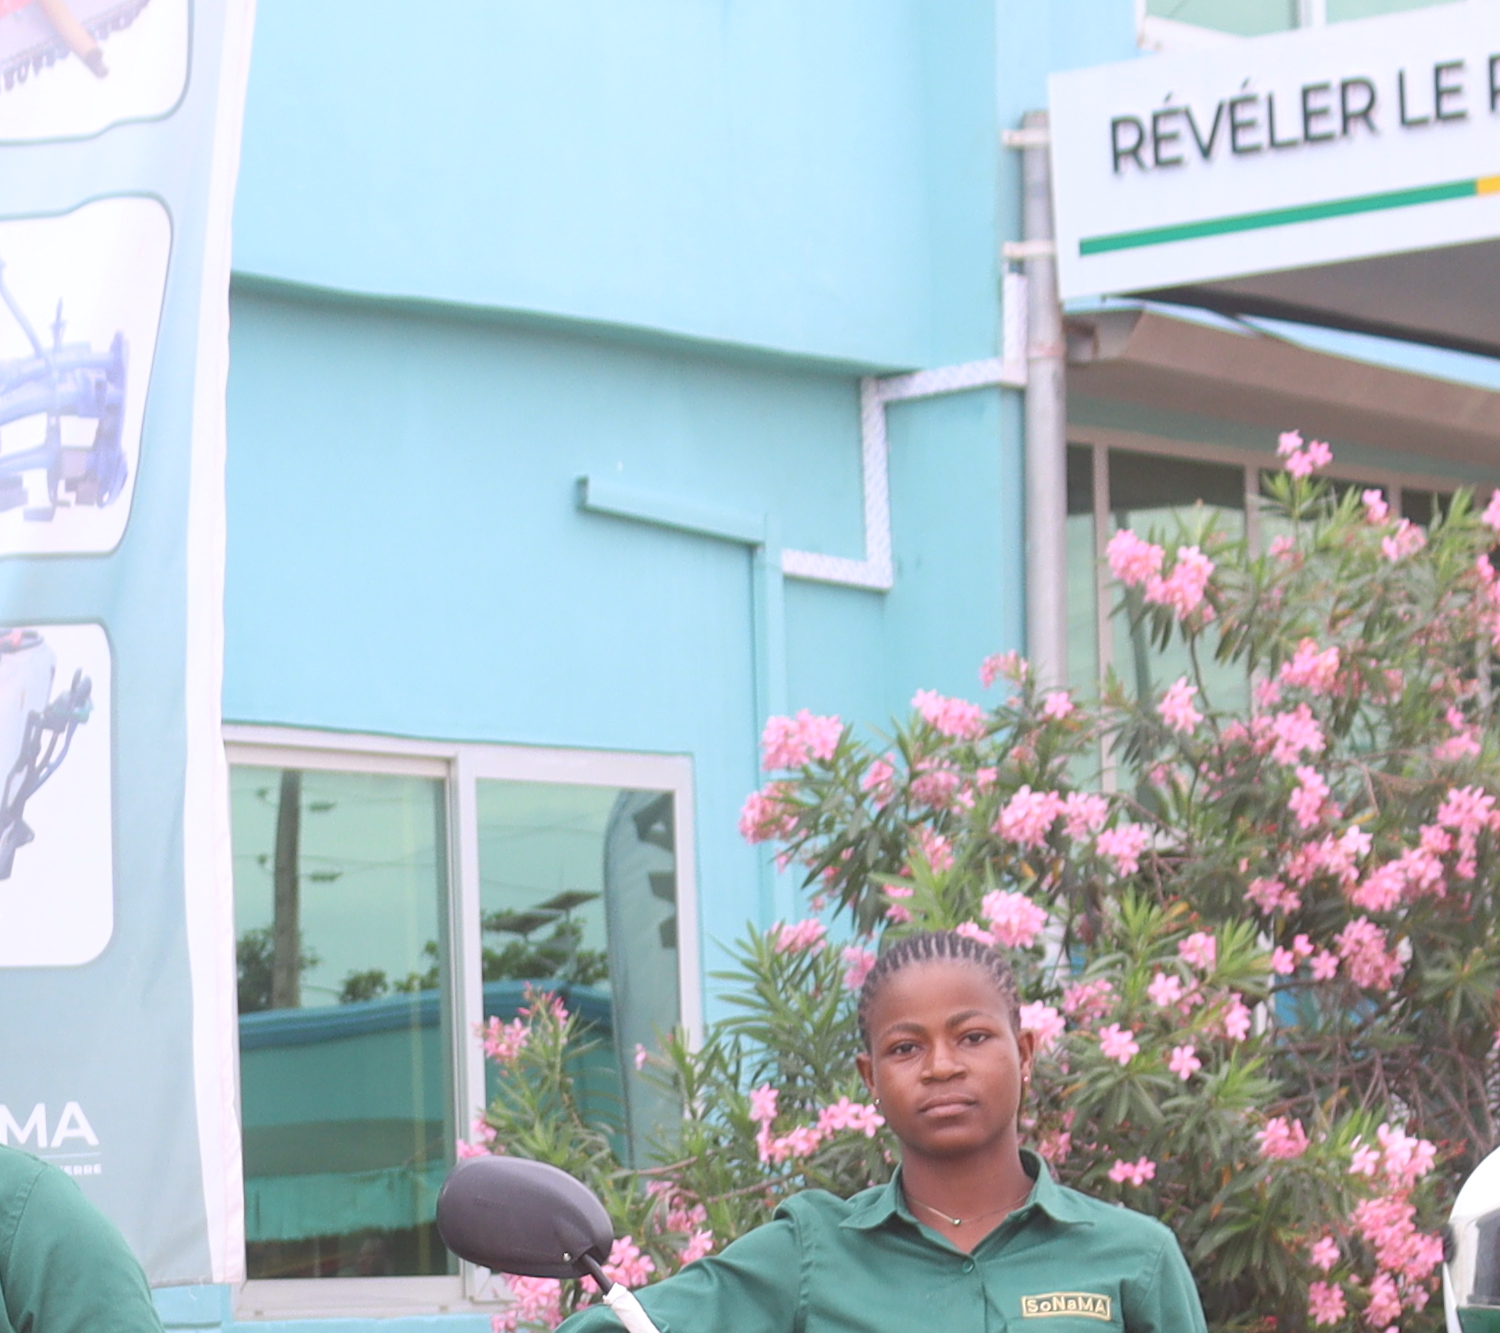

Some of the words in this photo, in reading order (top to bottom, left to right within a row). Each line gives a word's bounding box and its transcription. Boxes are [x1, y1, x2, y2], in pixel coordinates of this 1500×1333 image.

[1110, 76, 1377, 174] RÉVÉLER
[1398, 60, 1469, 128] LE
[1026, 1296, 1107, 1314] SoNaMA
